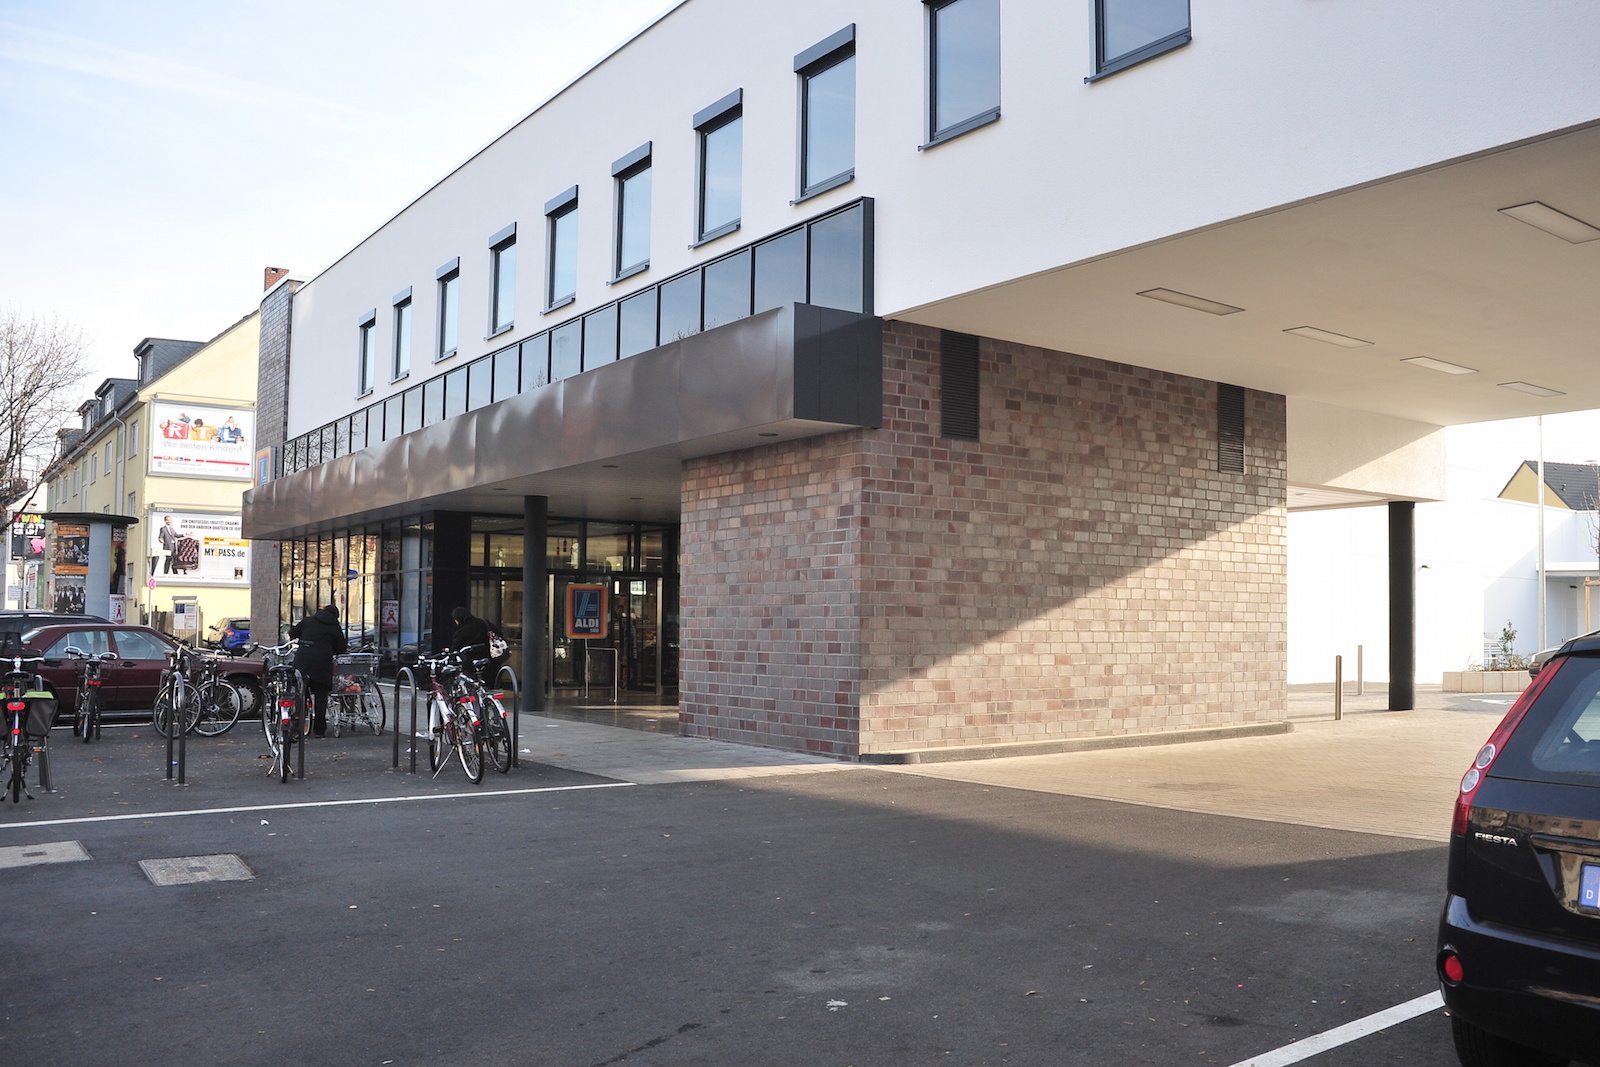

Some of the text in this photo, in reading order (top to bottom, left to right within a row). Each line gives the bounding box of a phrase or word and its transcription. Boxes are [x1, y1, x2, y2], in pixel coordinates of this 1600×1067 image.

[575, 618, 599, 628] ALDI
[1474, 832, 1518, 847] FIESTA
[1586, 889, 1594, 899] D
